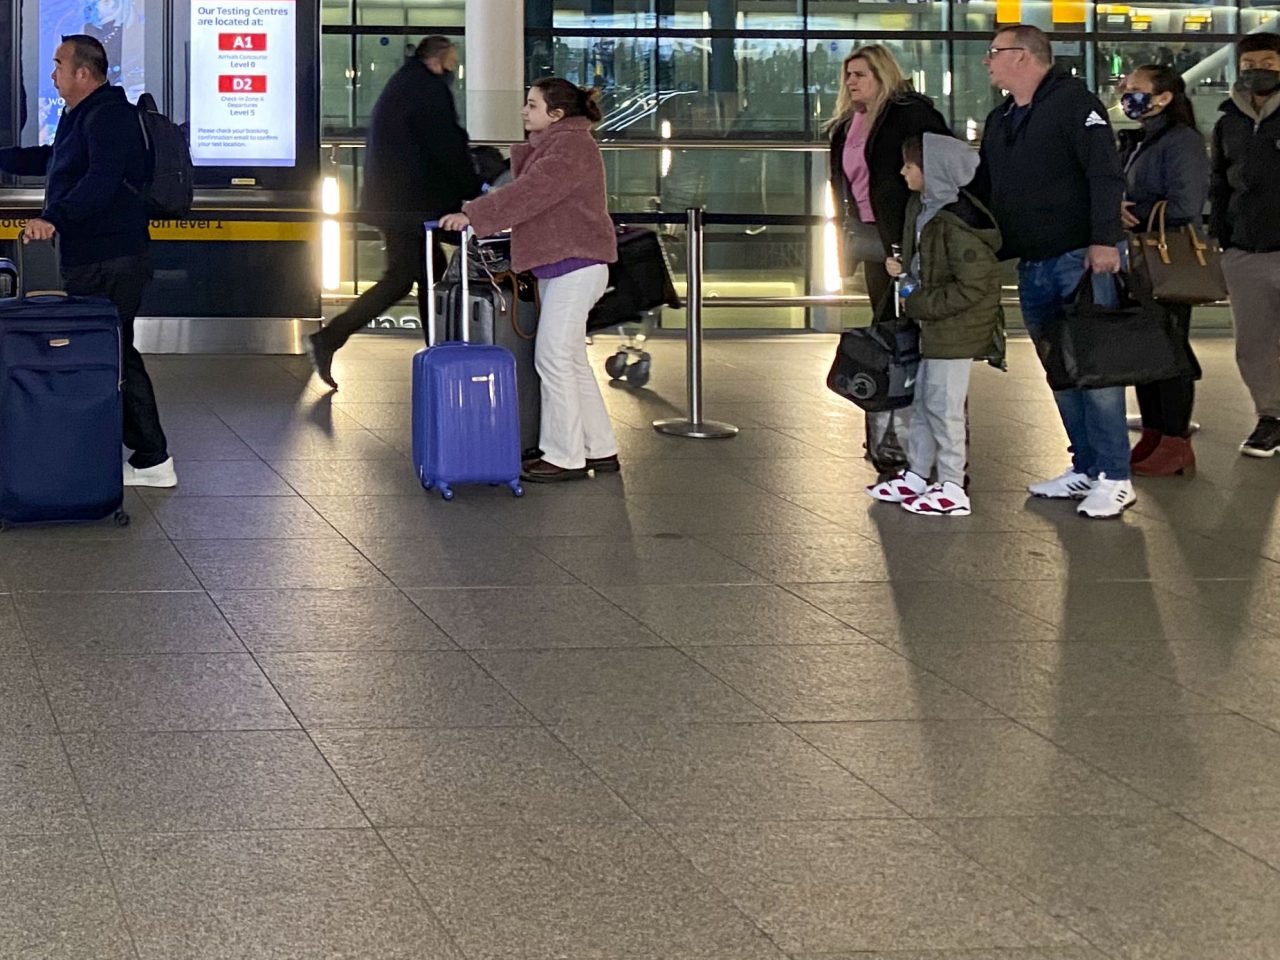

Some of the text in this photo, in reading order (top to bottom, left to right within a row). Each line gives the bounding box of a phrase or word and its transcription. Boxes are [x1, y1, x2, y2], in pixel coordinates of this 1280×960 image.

[197, 6, 289, 17] Our Testing Centres
[197, 16, 264, 26] are located at:
[233, 36, 253, 48] A1
[233, 78, 253, 90] D2
